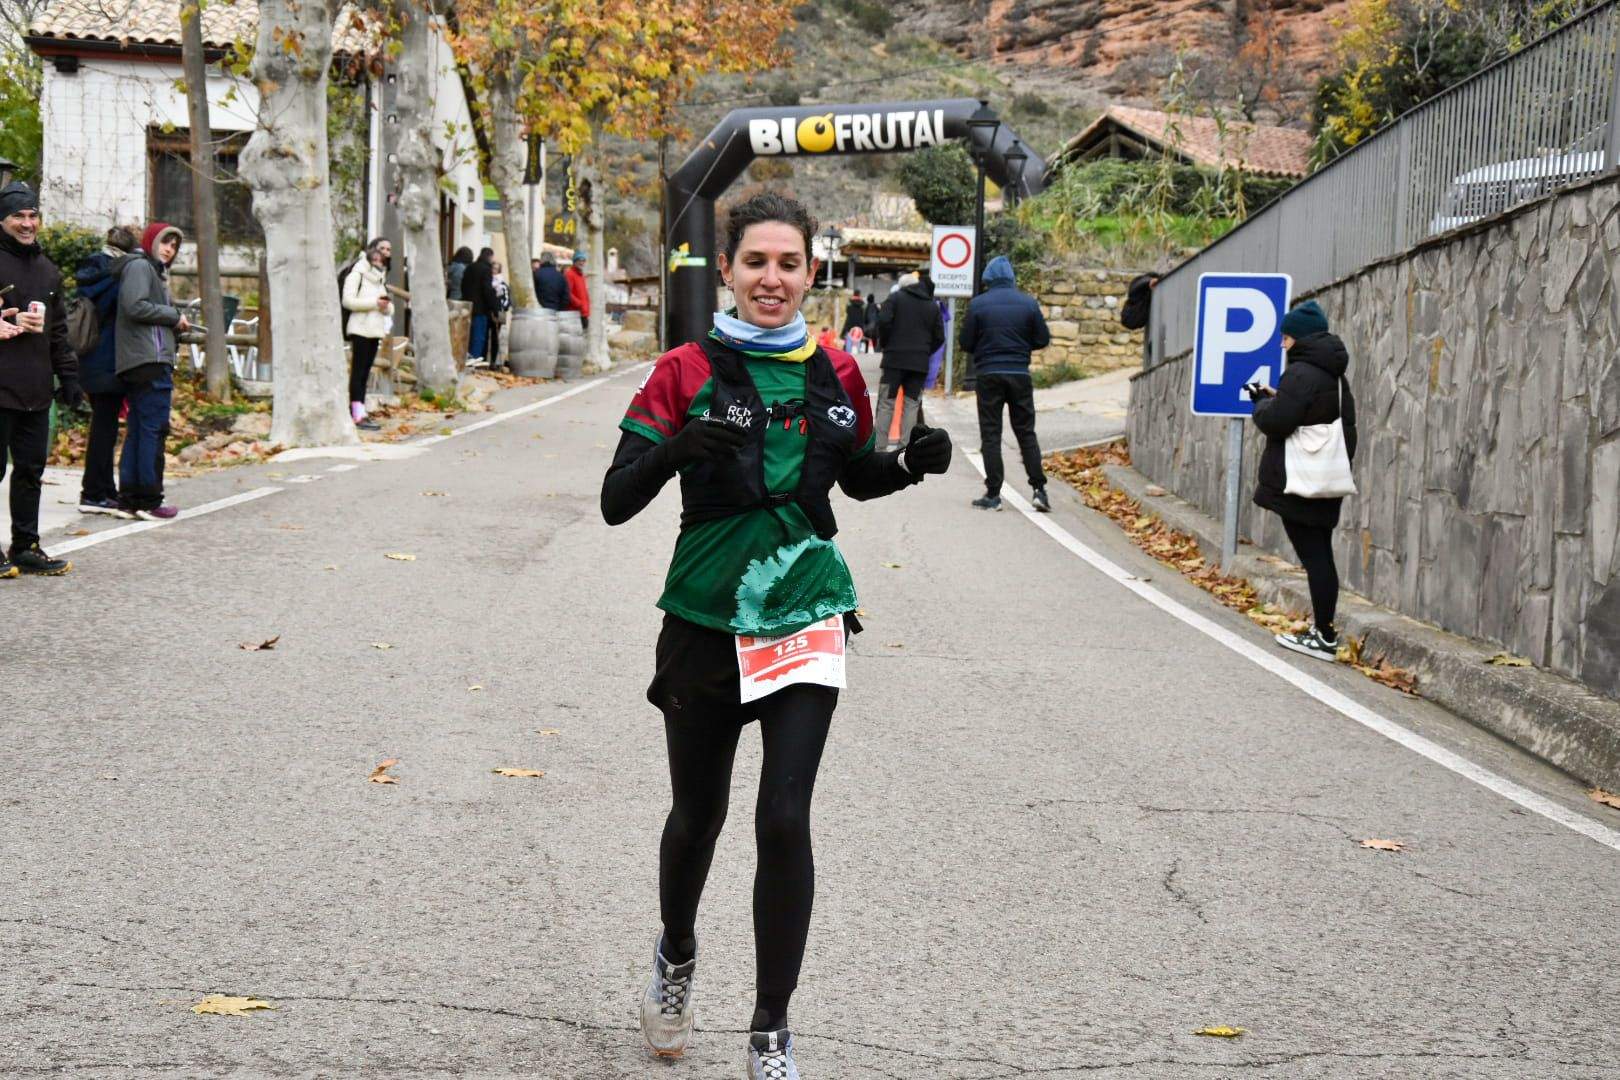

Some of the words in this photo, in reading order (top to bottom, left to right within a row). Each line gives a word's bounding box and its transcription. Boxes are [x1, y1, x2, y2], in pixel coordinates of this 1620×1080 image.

[749, 109, 952, 154] BIOFRUTAL
[554, 219, 575, 234] BA
[1200, 287, 1277, 385] P
[773, 635, 808, 657] 125
